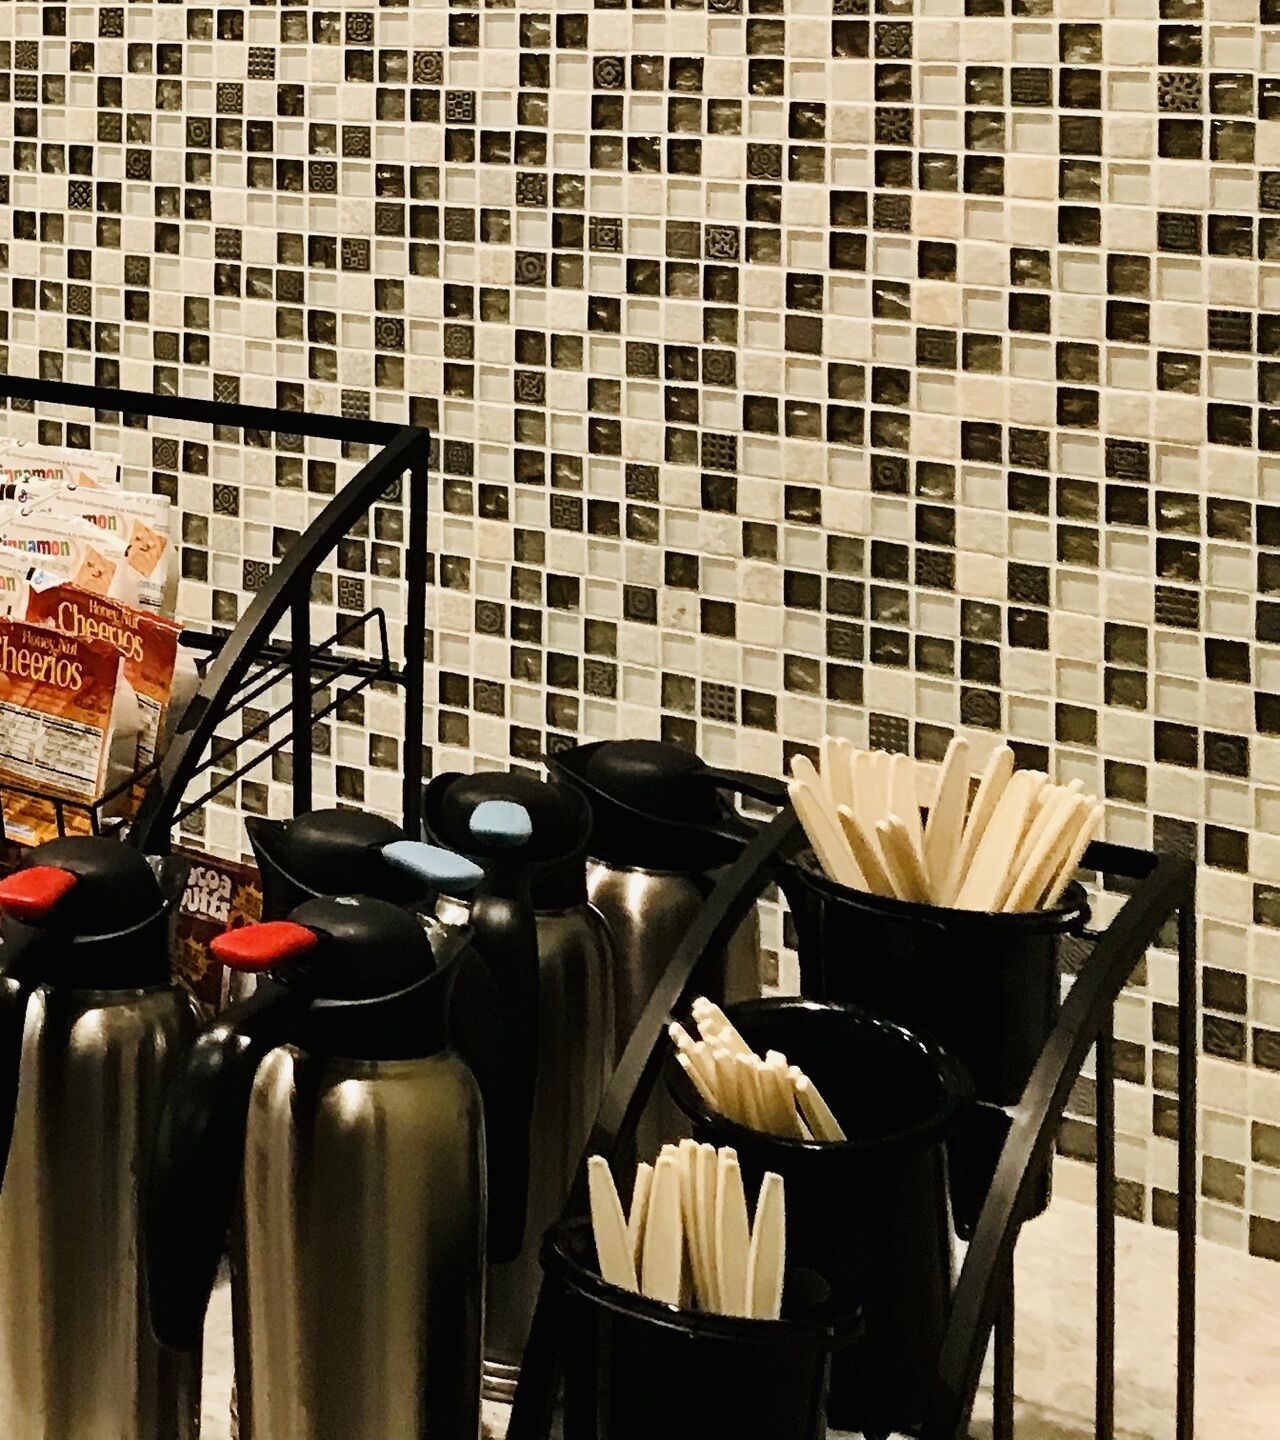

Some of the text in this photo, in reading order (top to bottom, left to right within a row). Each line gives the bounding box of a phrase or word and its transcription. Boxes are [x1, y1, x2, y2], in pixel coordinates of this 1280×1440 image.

[90, 600, 117, 623] Honey
[22, 630, 78, 656] Honey Nut
[58, 601, 144, 662] Cheerios
